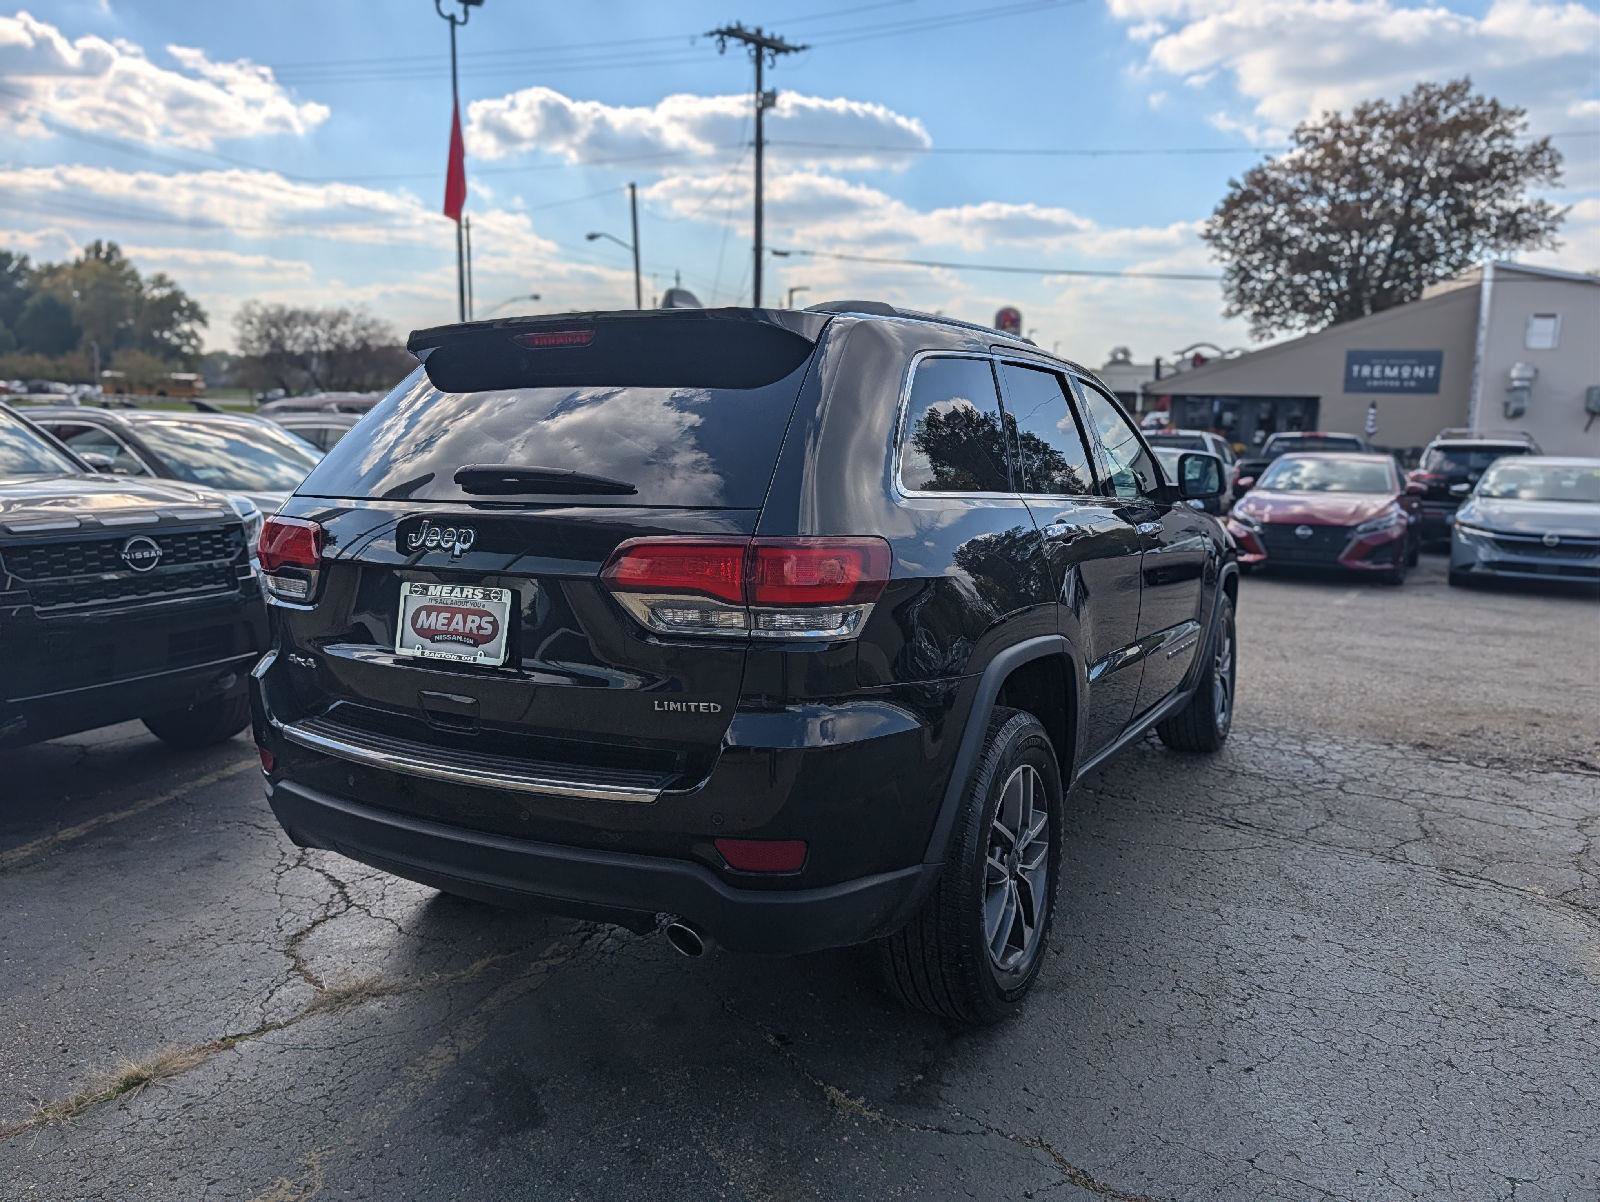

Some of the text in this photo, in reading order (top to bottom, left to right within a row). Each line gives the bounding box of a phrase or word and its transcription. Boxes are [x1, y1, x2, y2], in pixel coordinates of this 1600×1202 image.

[1352, 365, 1436, 378] TREMONT
[408, 520, 474, 555] Jeep
[121, 549, 162, 560] NISSAN
[428, 585, 484, 600] MEARS
[449, 599, 469, 607] ABOUT
[416, 610, 494, 635] MEARS
[654, 700, 722, 713] LIMITED
